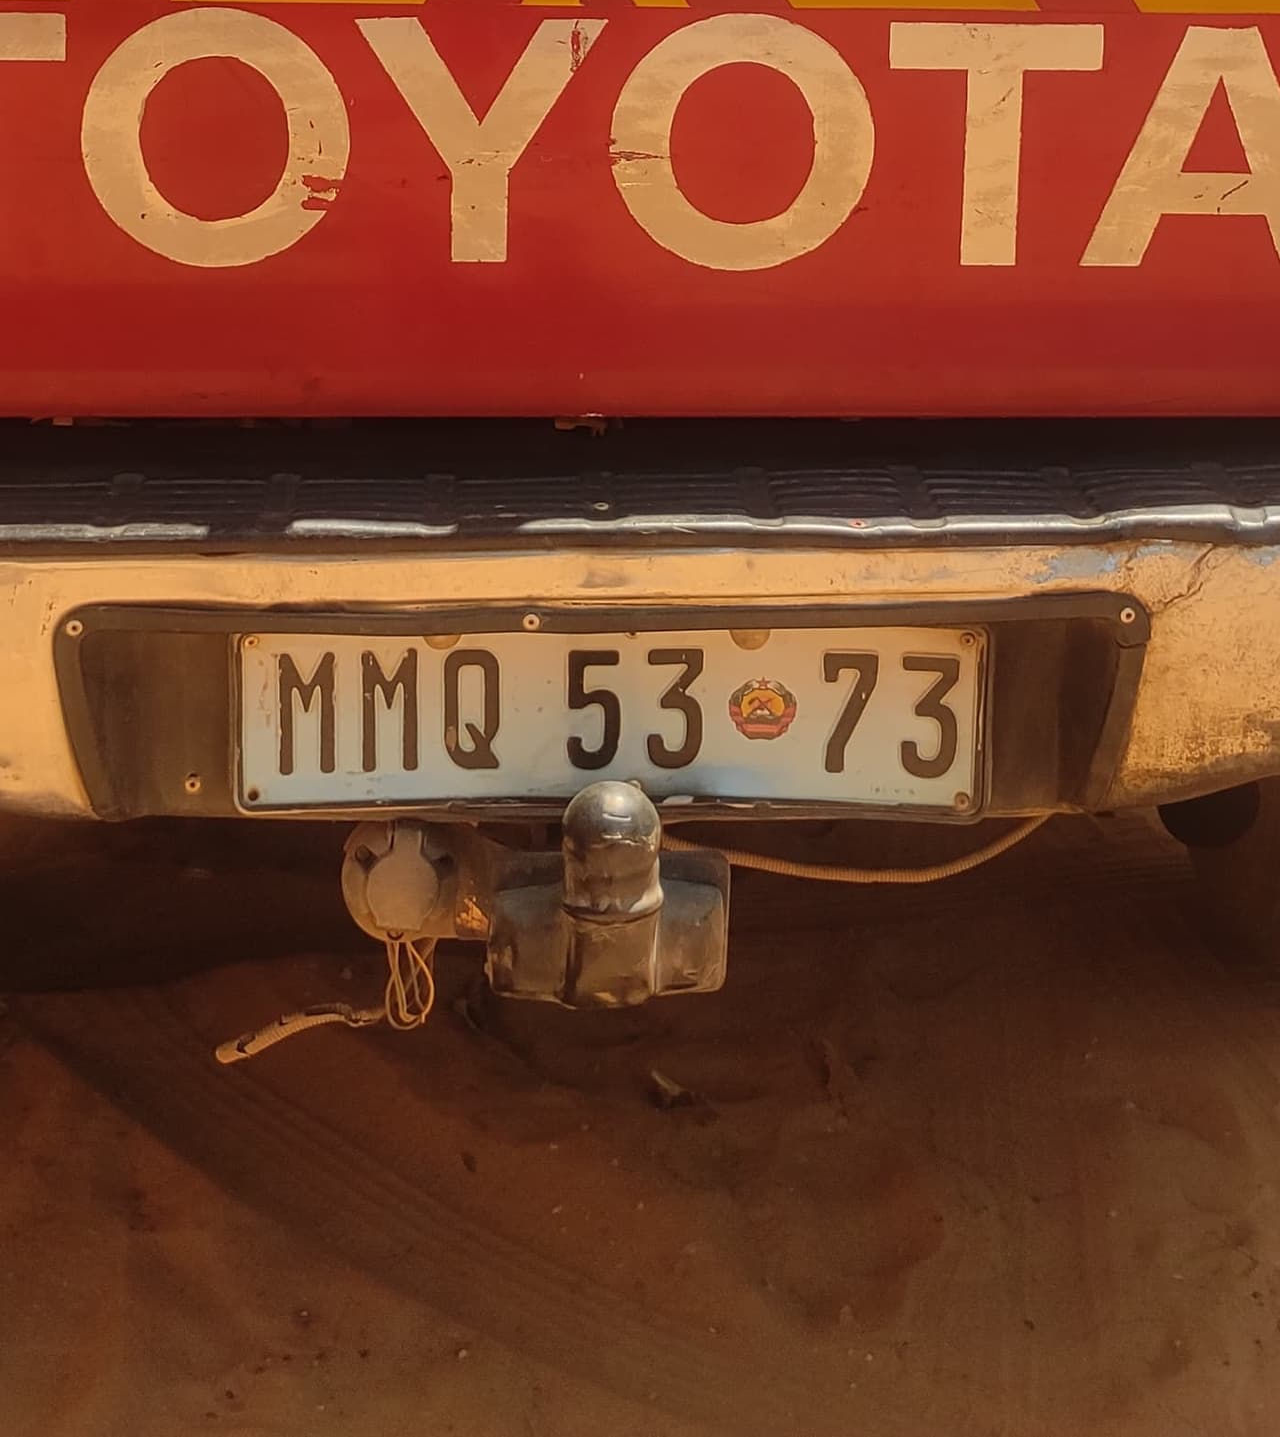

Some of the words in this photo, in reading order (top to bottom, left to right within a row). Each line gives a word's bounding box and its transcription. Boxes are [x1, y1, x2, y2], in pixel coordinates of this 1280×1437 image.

[278, 647, 500, 776] MMQ
[566, 647, 705, 770] 53
[823, 652, 962, 779] 73
